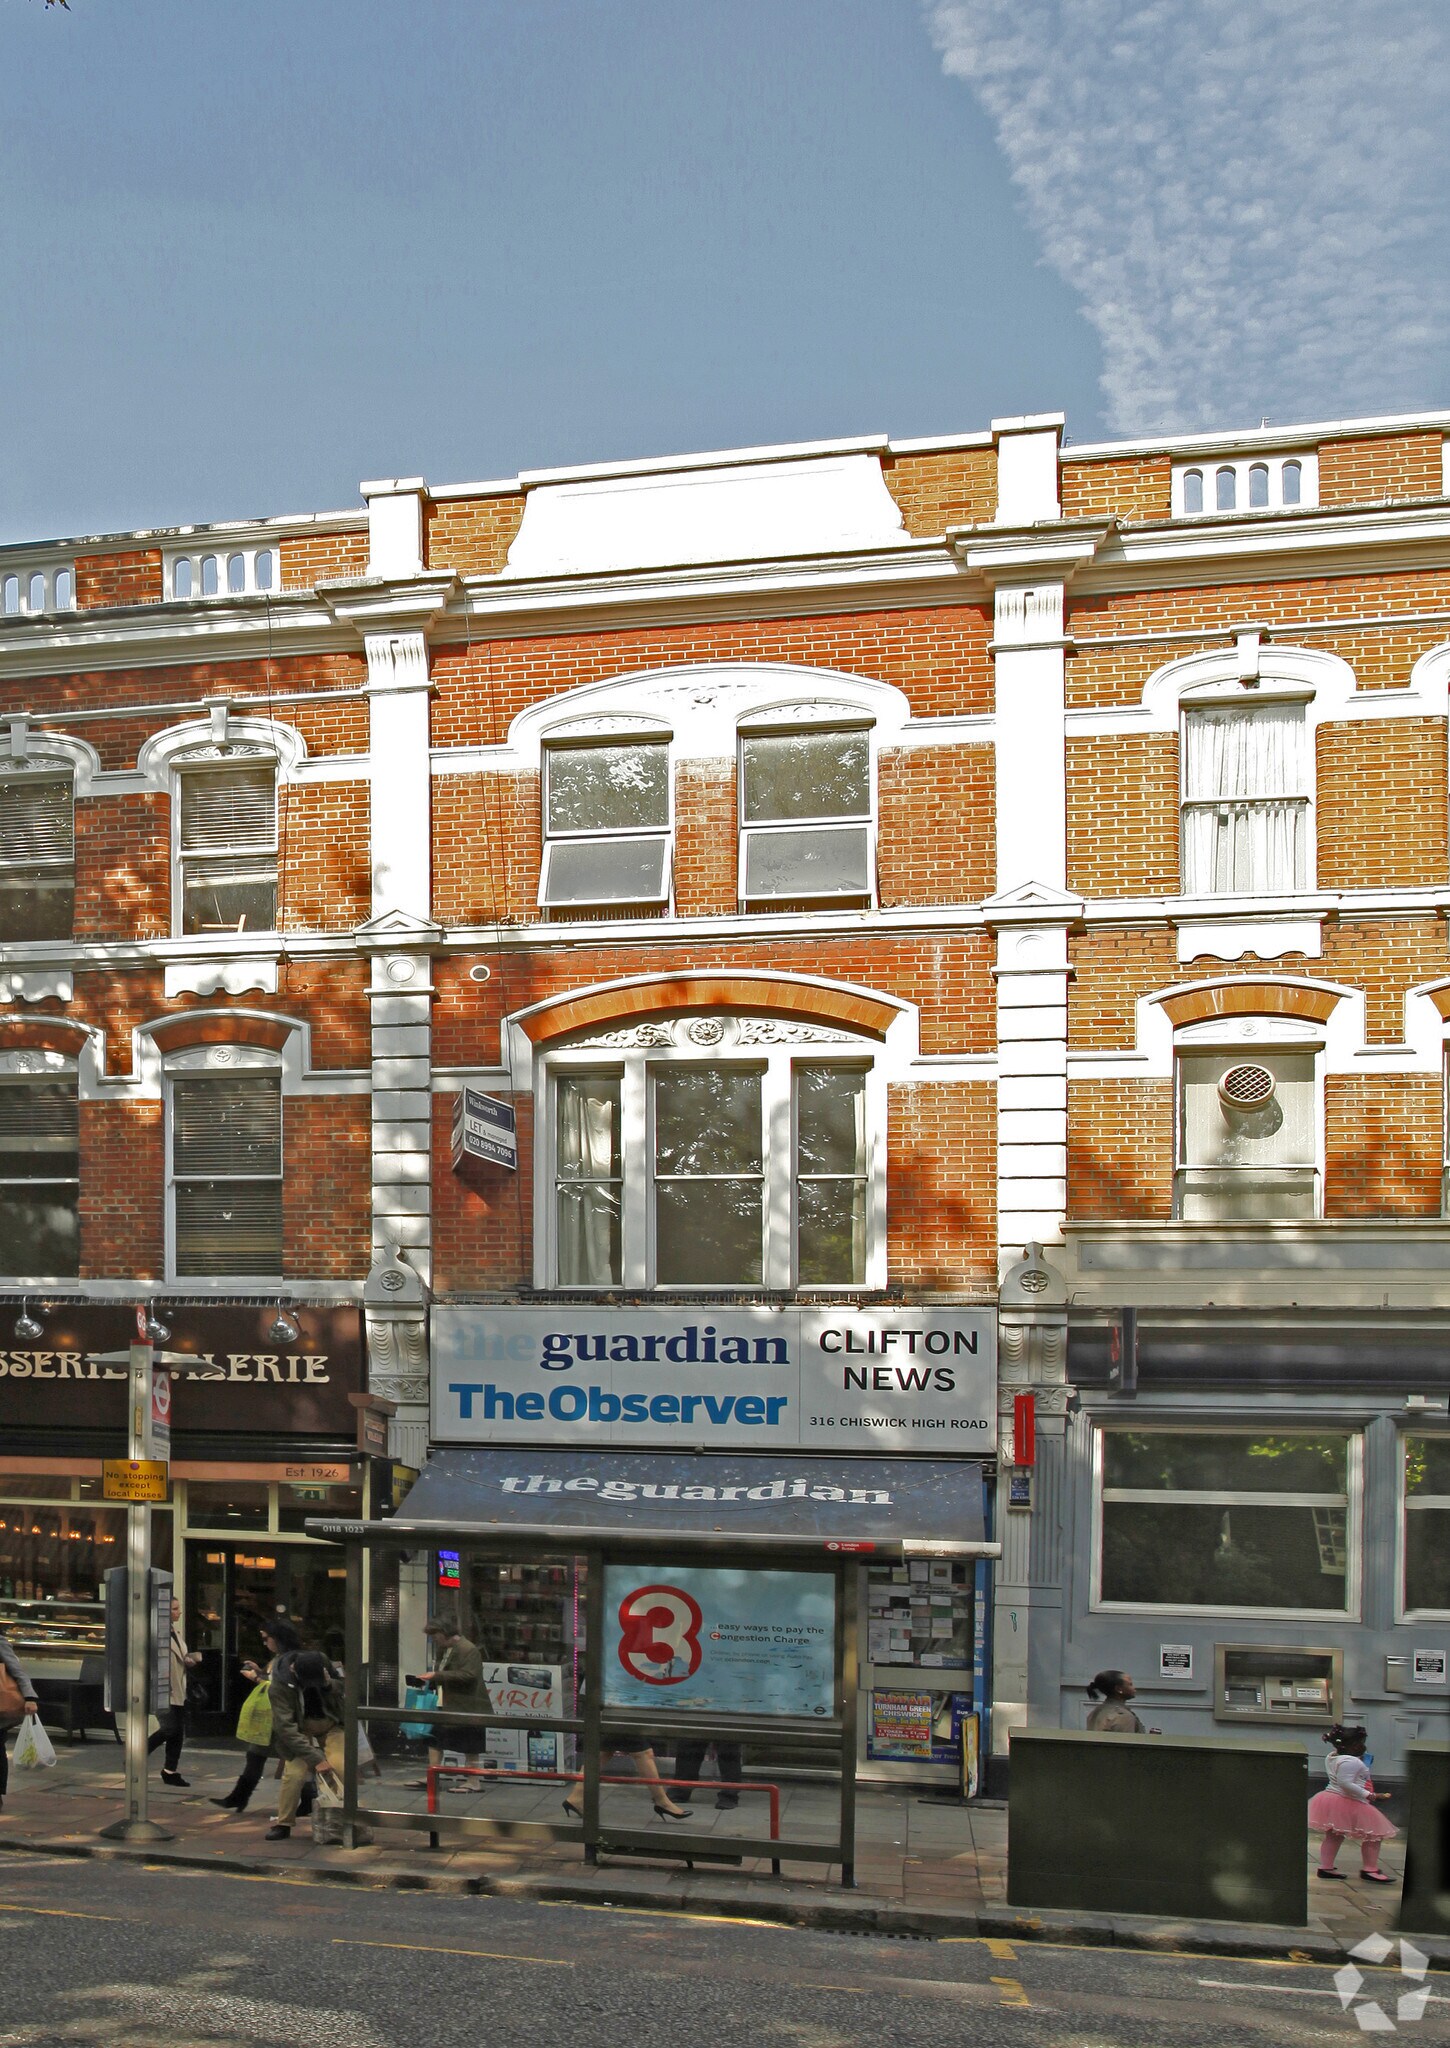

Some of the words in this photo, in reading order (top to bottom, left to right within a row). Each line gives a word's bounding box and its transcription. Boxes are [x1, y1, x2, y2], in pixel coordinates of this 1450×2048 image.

[469, 1097, 498, 1116] Winkworth
[469, 1120, 482, 1134] LET
[469, 1136, 480, 1146] 020
[480, 1141, 496, 1153] 8994
[496, 1146, 512, 1159] 7096
[819, 1329, 978, 1355] CLIFTON
[540, 1326, 791, 1371] guardian
[843, 1366, 956, 1391] NEWS
[809, 1417, 835, 1426] 316
[840, 1417, 908, 1428] CHISWICK
[912, 1418, 946, 1429] HIGH
[950, 1419, 989, 1429] ROAD
[123, 1472, 164, 1482] stopping
[285, 1467, 305, 1477] Est
[311, 1468, 339, 1478] 1926
[119, 1481, 150, 1489] except
[107, 1487, 130, 1498] local
[134, 1488, 162, 1499] buses
[322, 1525, 341, 1533] 0118
[344, 1525, 365, 1534] 1023
[619, 1586, 701, 1683] 3
[743, 1624, 769, 1632] ways
[785, 1626, 804, 1635] pay
[806, 1626, 825, 1634] the
[710, 1631, 771, 1642] Congestion
[773, 1635, 810, 1646] Charge
[874, 1703, 908, 1711] TURNHAM
[909, 1705, 932, 1713] GREEN
[883, 1710, 923, 1718] CHISWICK
